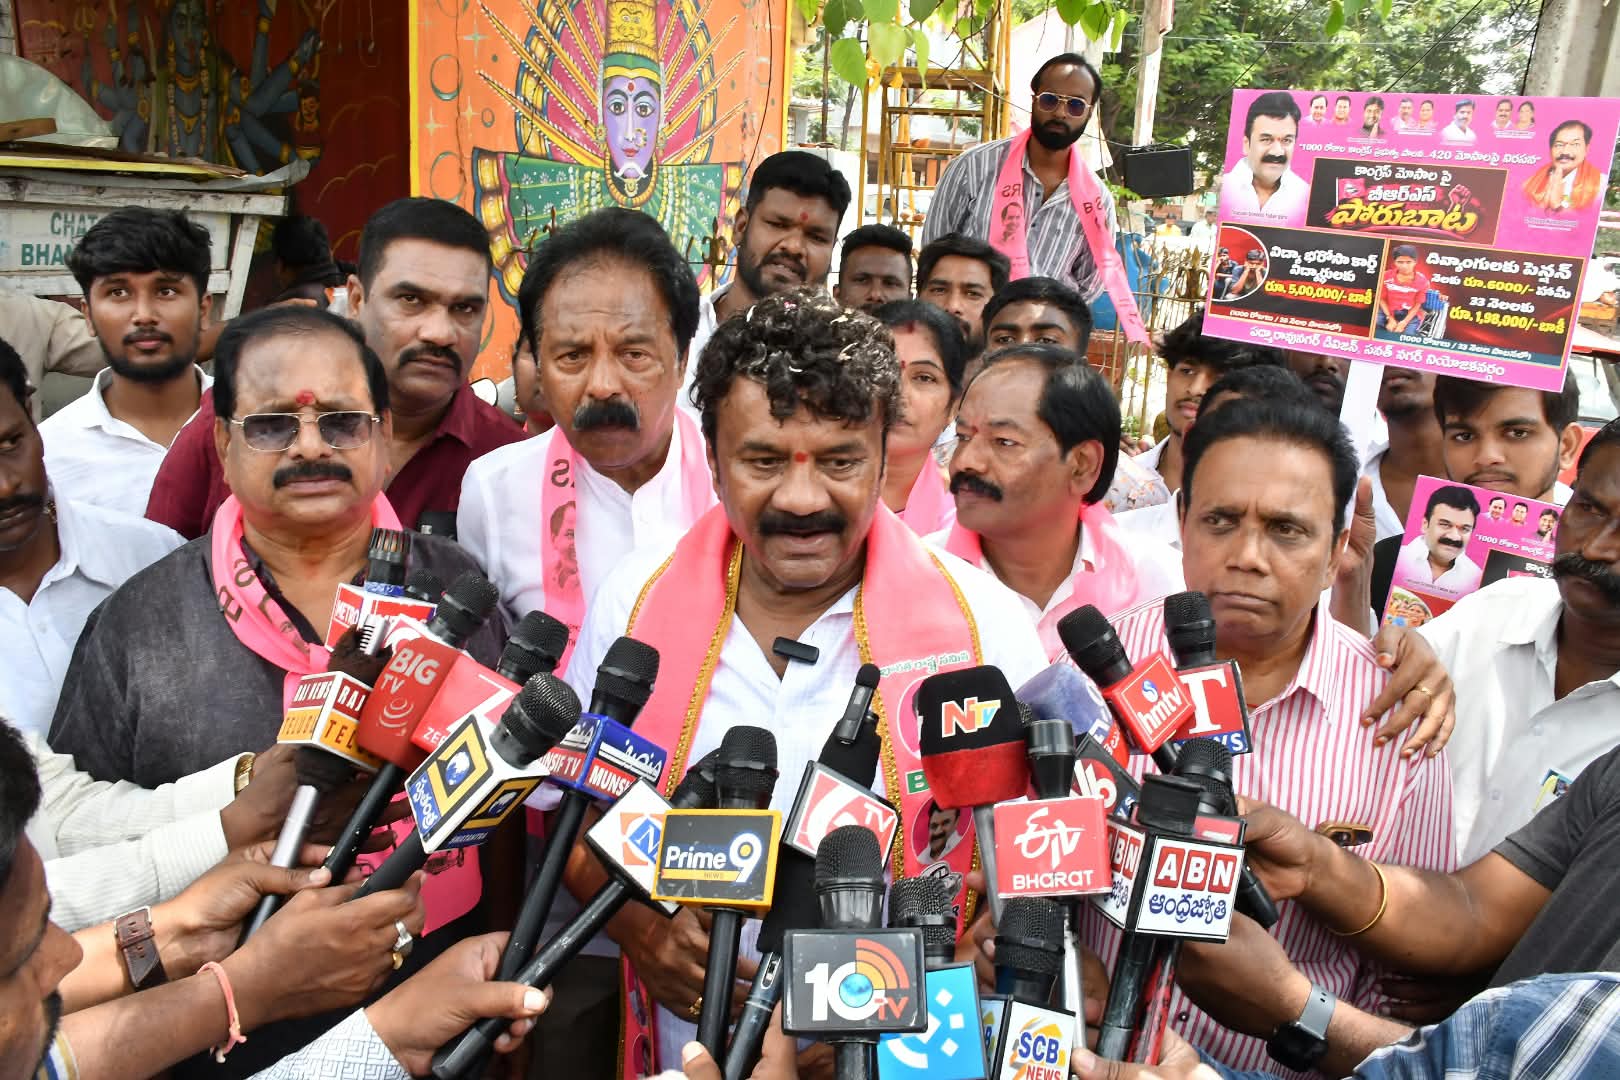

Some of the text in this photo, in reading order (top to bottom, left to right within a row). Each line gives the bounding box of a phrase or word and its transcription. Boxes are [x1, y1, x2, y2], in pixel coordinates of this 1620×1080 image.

[1354, 164, 1392, 180] కాంగ్రెస్
[1395, 167, 1438, 181] మోసాల
[1331, 198, 1478, 233] పోరుబాట
[388, 647, 440, 686] BIG
[337, 685, 366, 712] RAJ
[381, 673, 406, 695] TV
[942, 697, 1001, 738] NTV
[1137, 686, 1182, 736] hmtv
[1178, 667, 1227, 735] T
[325, 719, 357, 749] TEL
[564, 756, 582, 777] TV
[863, 802, 897, 832] TV
[1108, 835, 1139, 875] BN
[1157, 851, 1235, 889] ABN
[1149, 893, 1227, 924] ఆంధ్రజ్యోతి
[1018, 1031, 1059, 1064] SCB
